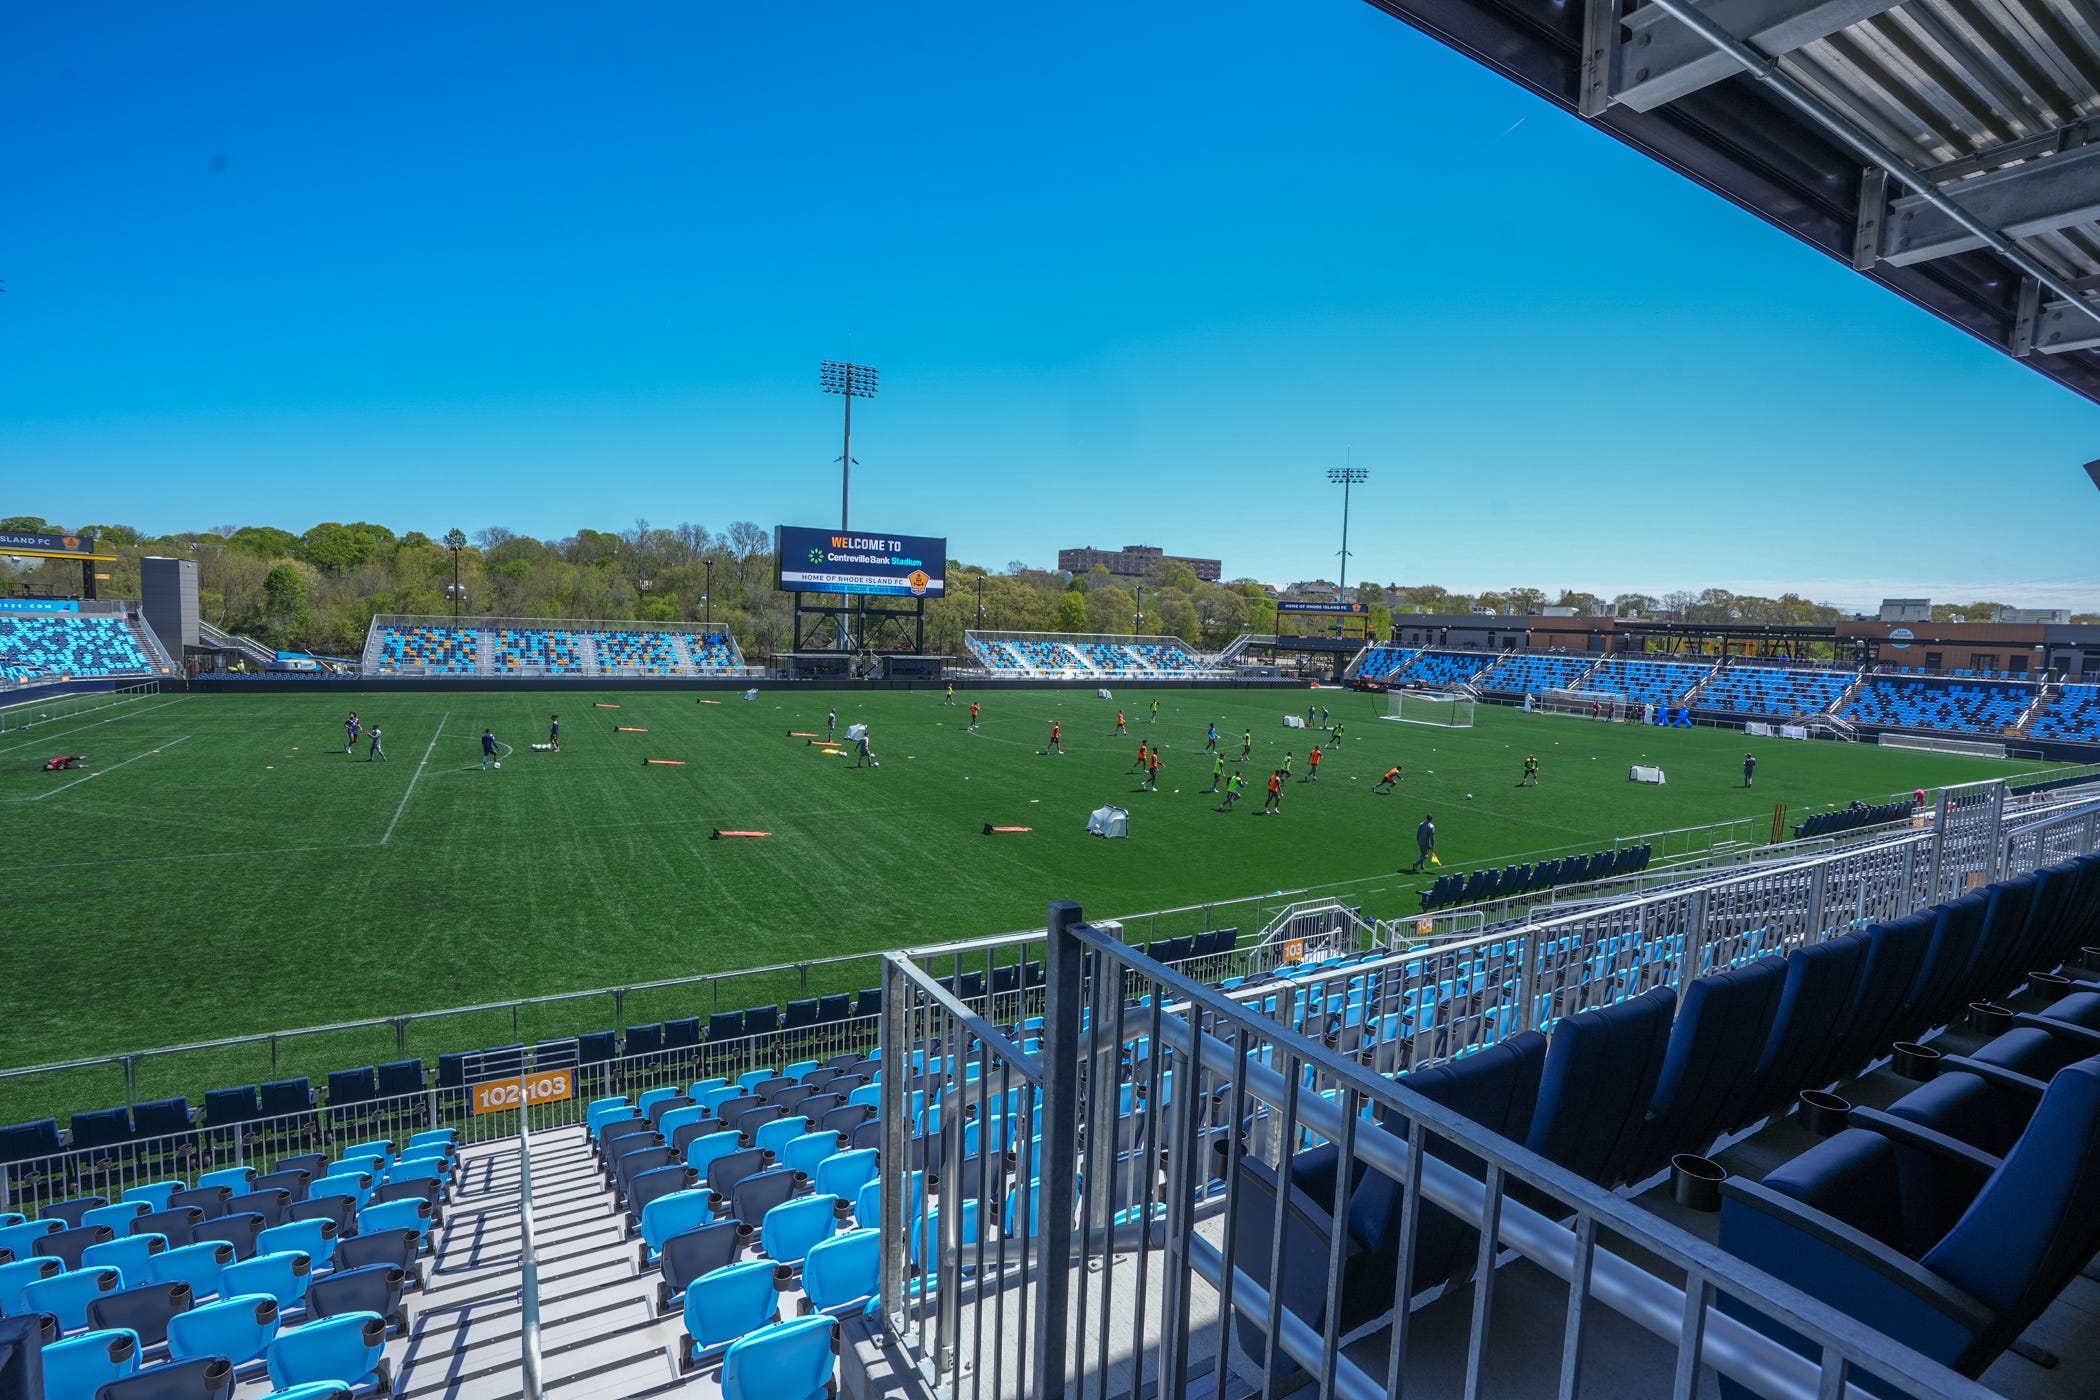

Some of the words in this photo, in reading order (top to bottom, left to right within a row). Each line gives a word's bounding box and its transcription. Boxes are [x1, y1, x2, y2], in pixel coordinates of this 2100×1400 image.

[38, 538, 51, 546] FC
[831, 536, 885, 551] WELCOME
[888, 541, 901, 552] TO
[891, 557, 922, 567] Stadium
[866, 577, 893, 585] ISLAND
[1284, 943, 1303, 958] 103
